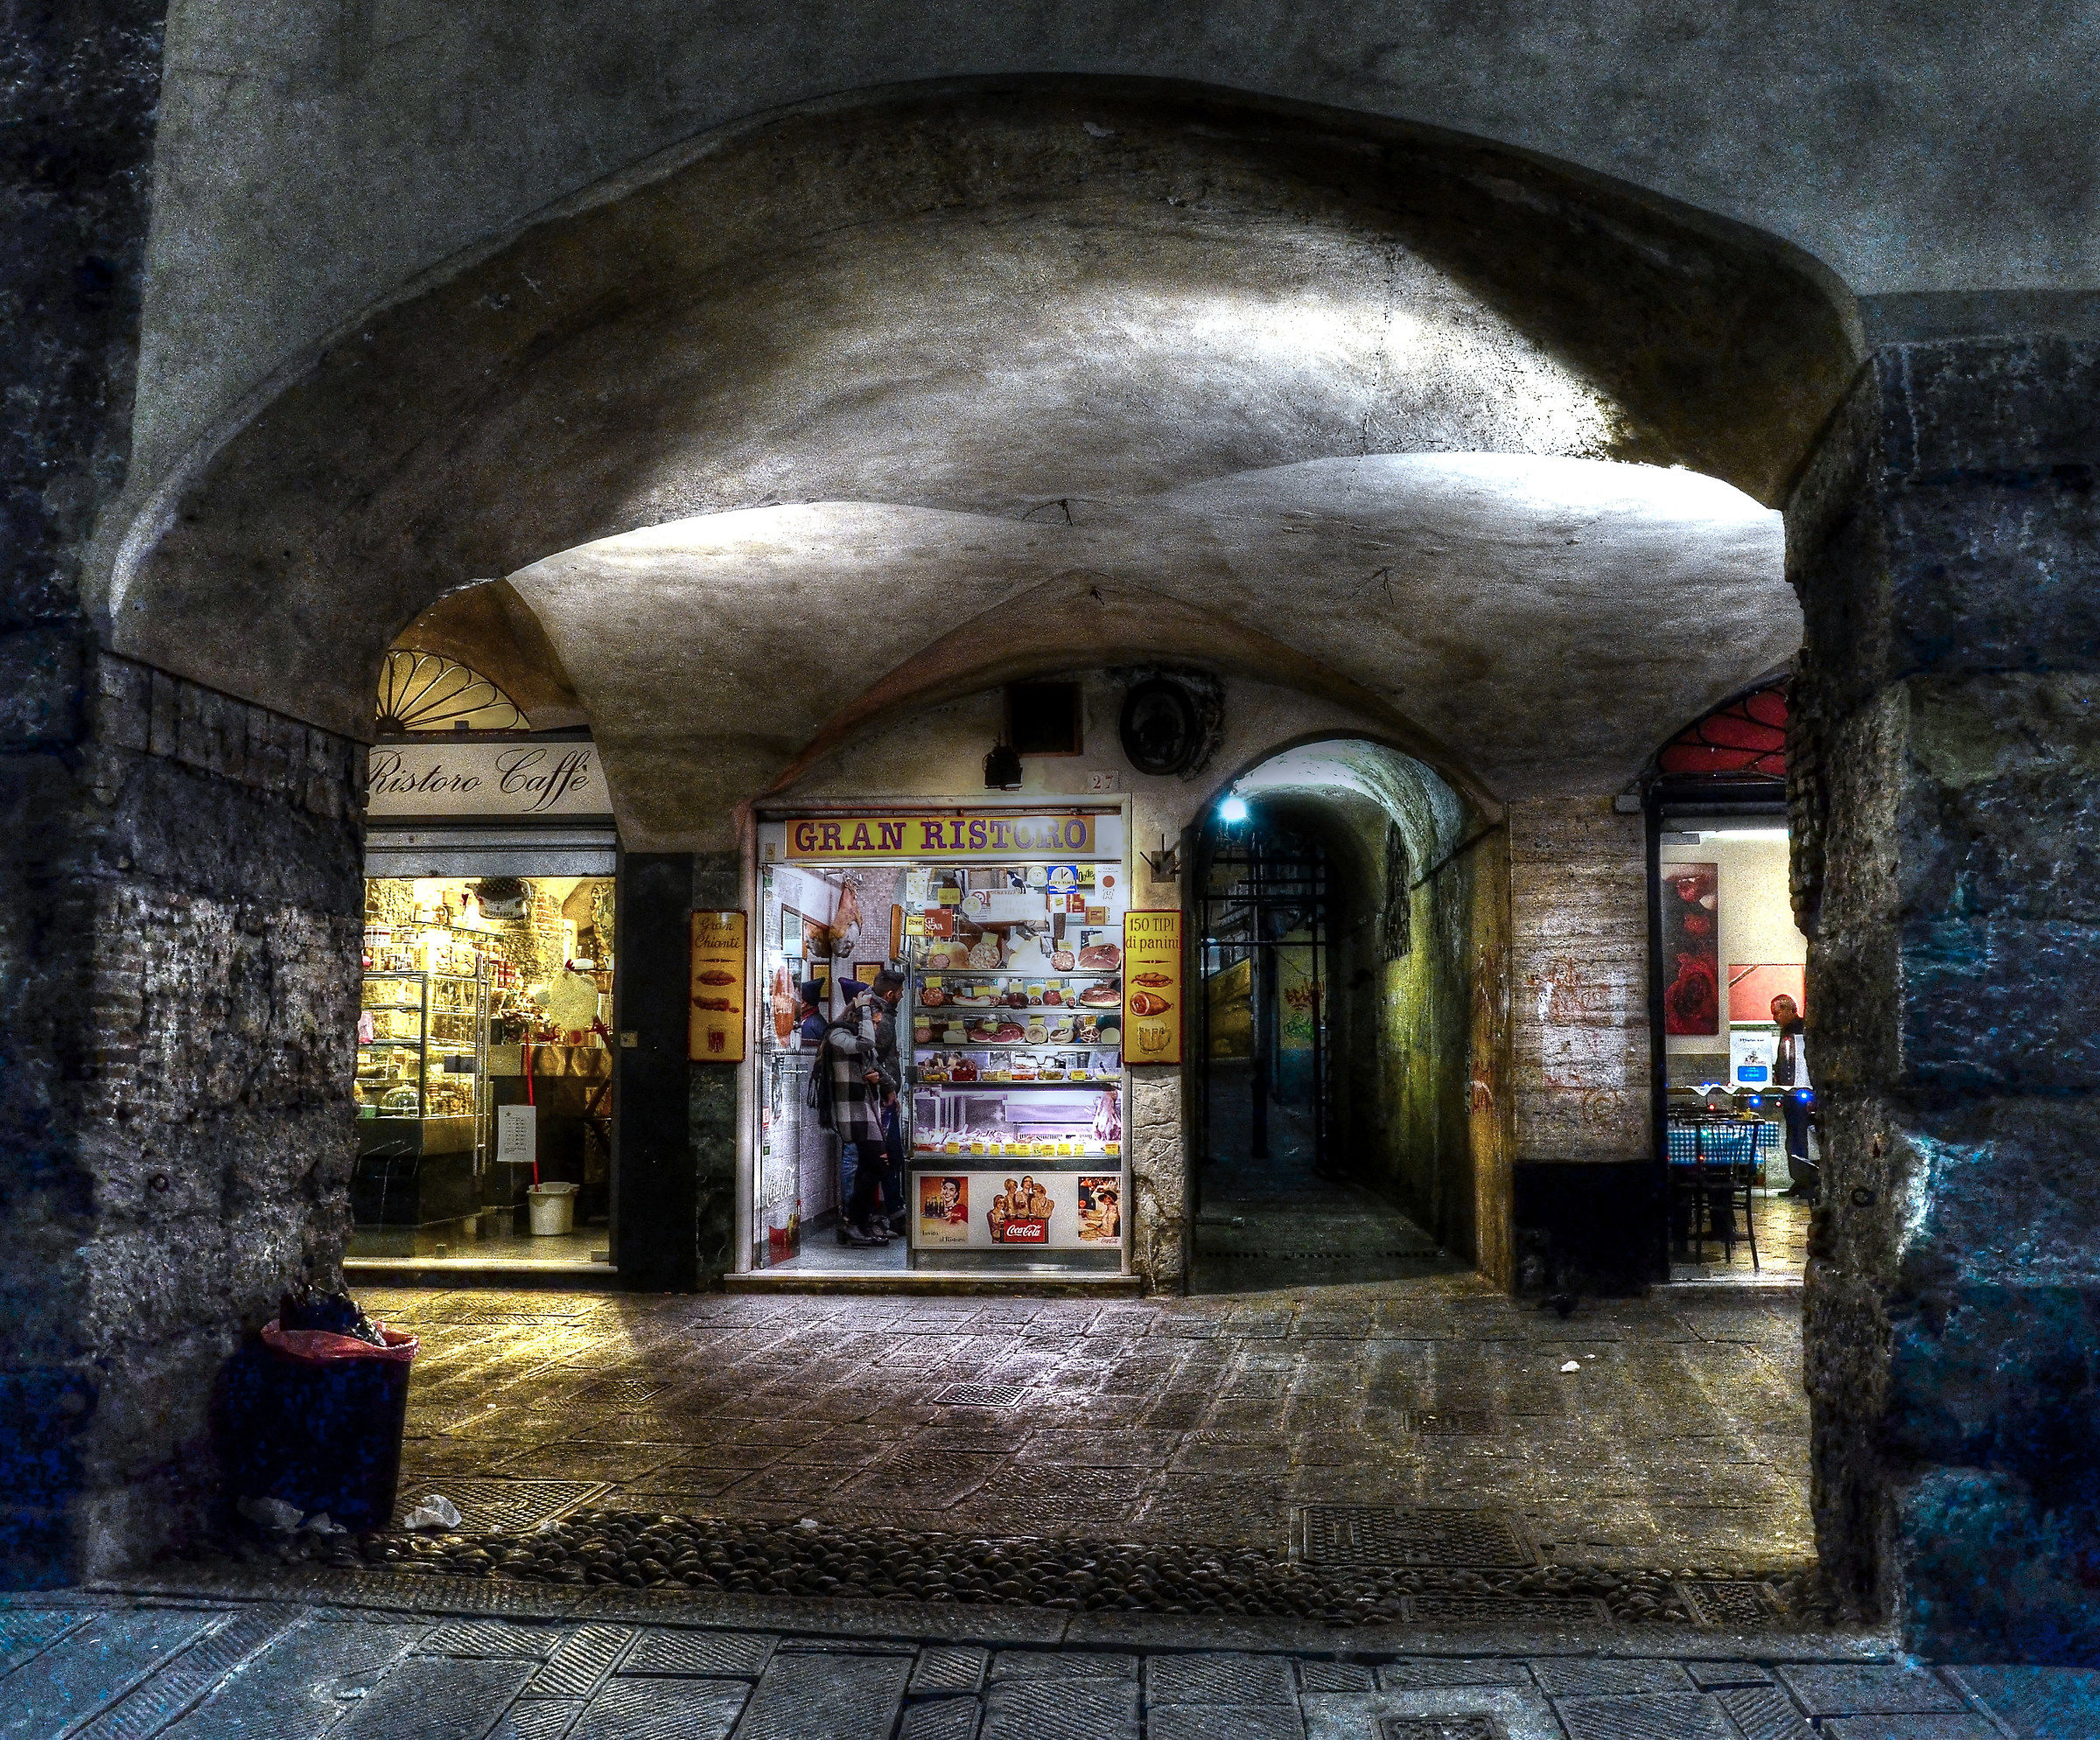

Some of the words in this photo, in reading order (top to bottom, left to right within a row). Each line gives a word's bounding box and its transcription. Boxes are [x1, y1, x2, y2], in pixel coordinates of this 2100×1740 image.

[368, 750, 481, 793] Ristoro
[495, 748, 592, 812] Caffè
[1093, 775, 1113, 789] 27
[794, 821, 906, 852] GRAN
[920, 819, 1088, 851] RISTORO
[1130, 918, 1150, 932] 150
[1152, 918, 1175, 932] TIPI
[695, 934, 741, 948] Chianti
[1125, 935, 1137, 949] di
[1139, 935, 1180, 953] panini
